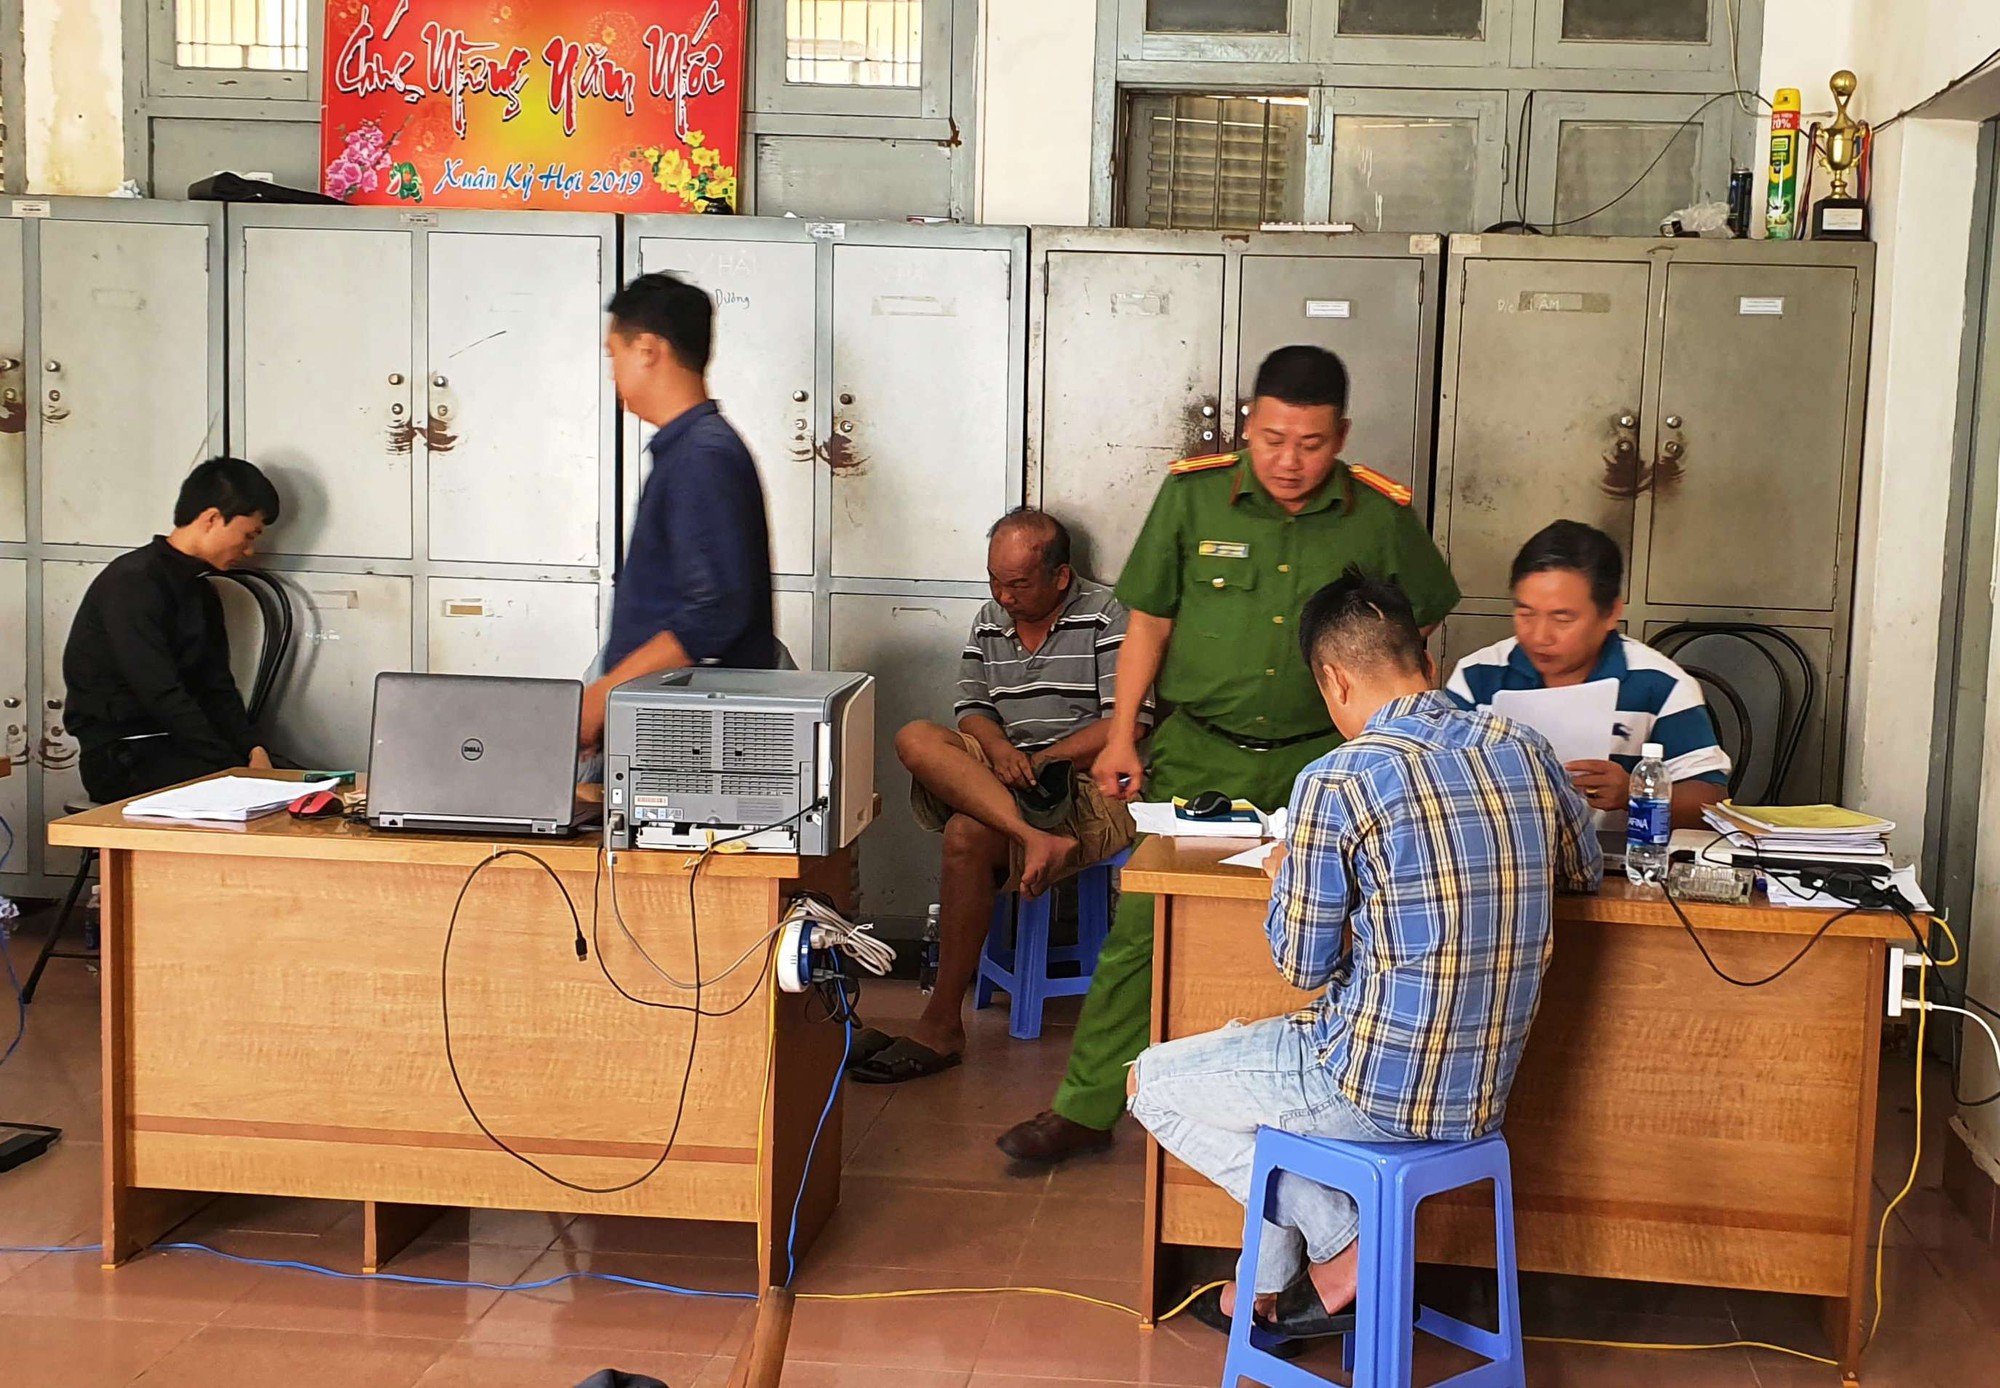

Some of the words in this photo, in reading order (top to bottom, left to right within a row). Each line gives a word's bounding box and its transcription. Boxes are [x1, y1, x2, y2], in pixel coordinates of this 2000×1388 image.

[543, 35, 636, 136] Năm
[433, 158, 498, 195] Xuân
[502, 162, 535, 201] Kỷ
[537, 162, 584, 199] Hợi
[587, 171, 644, 195] 2019
